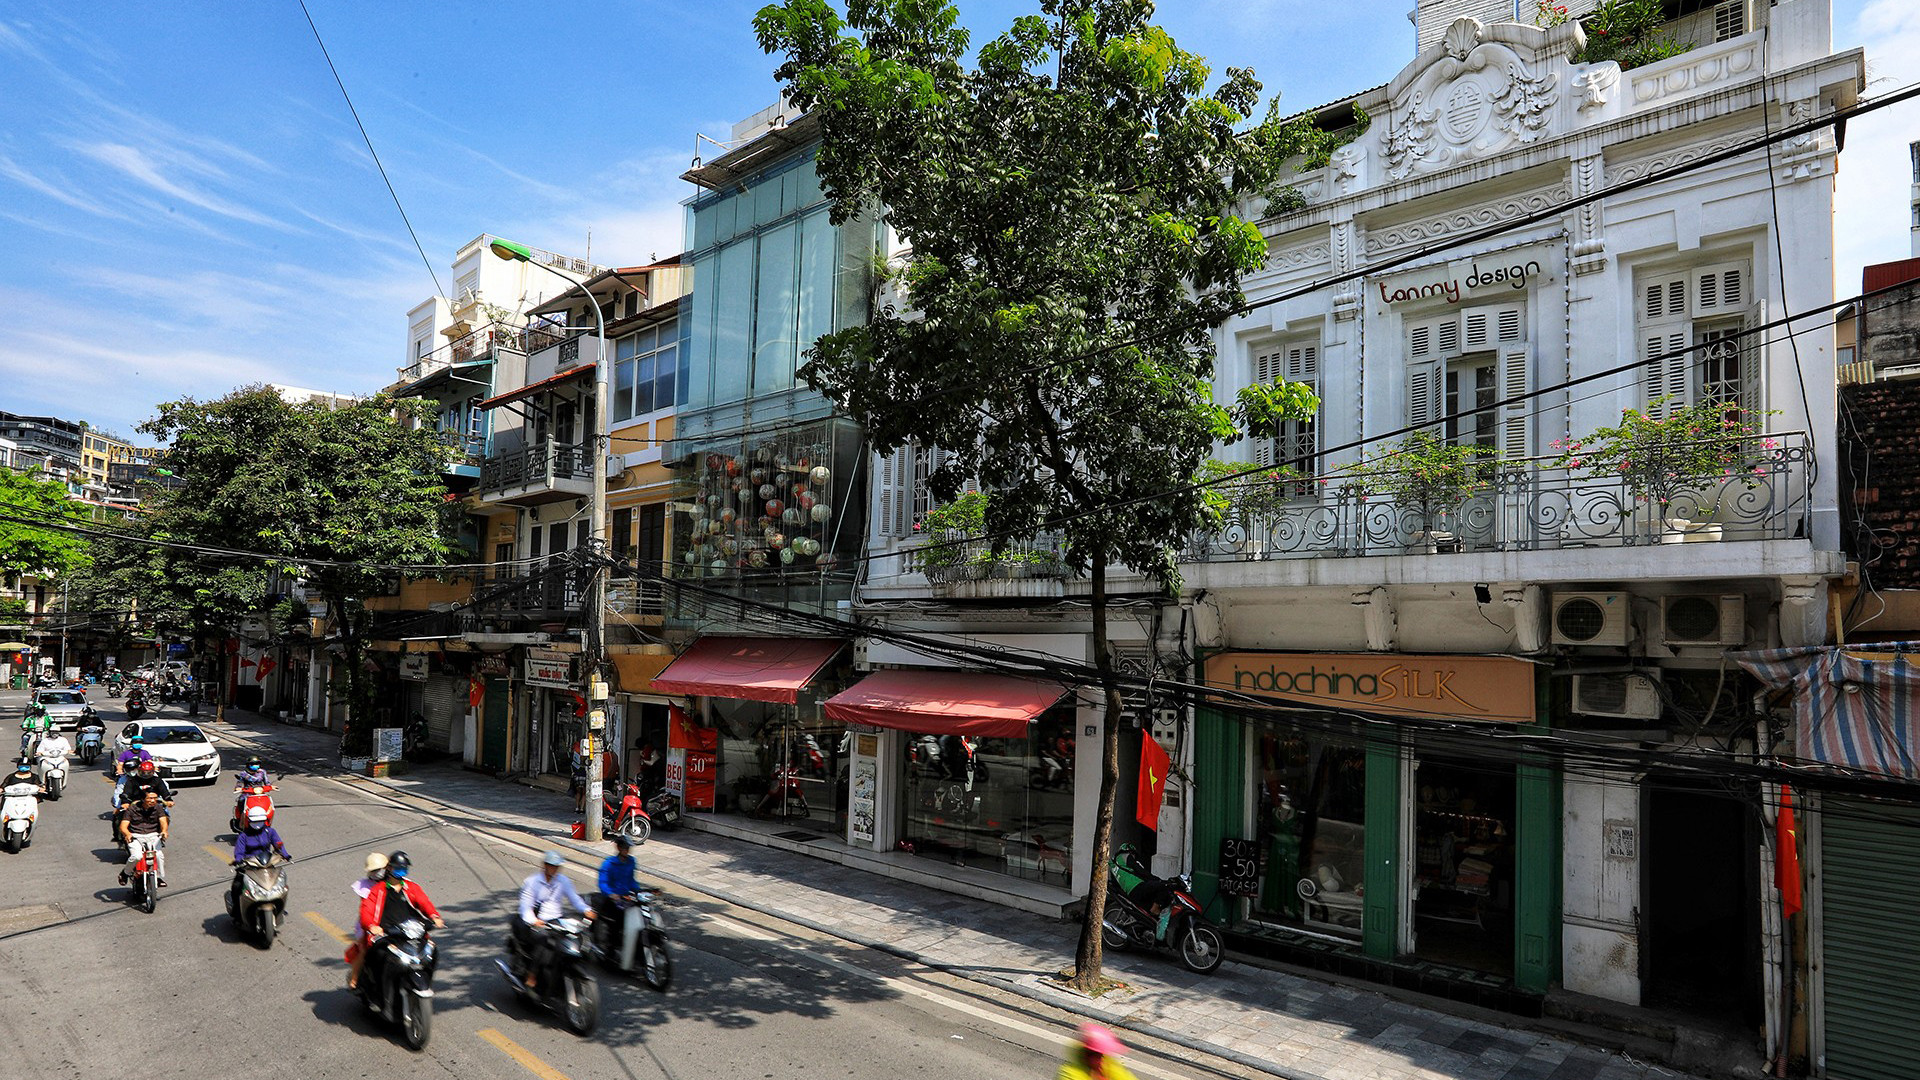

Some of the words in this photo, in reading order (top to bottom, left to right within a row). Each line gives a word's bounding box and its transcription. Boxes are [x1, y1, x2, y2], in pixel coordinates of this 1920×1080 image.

[1379, 279, 1460, 304] tanmy
[1465, 261, 1541, 290] design
[110, 445, 137, 458] MAY
[1234, 664, 1378, 696] indochina
[667, 762, 682, 782] BÉO
